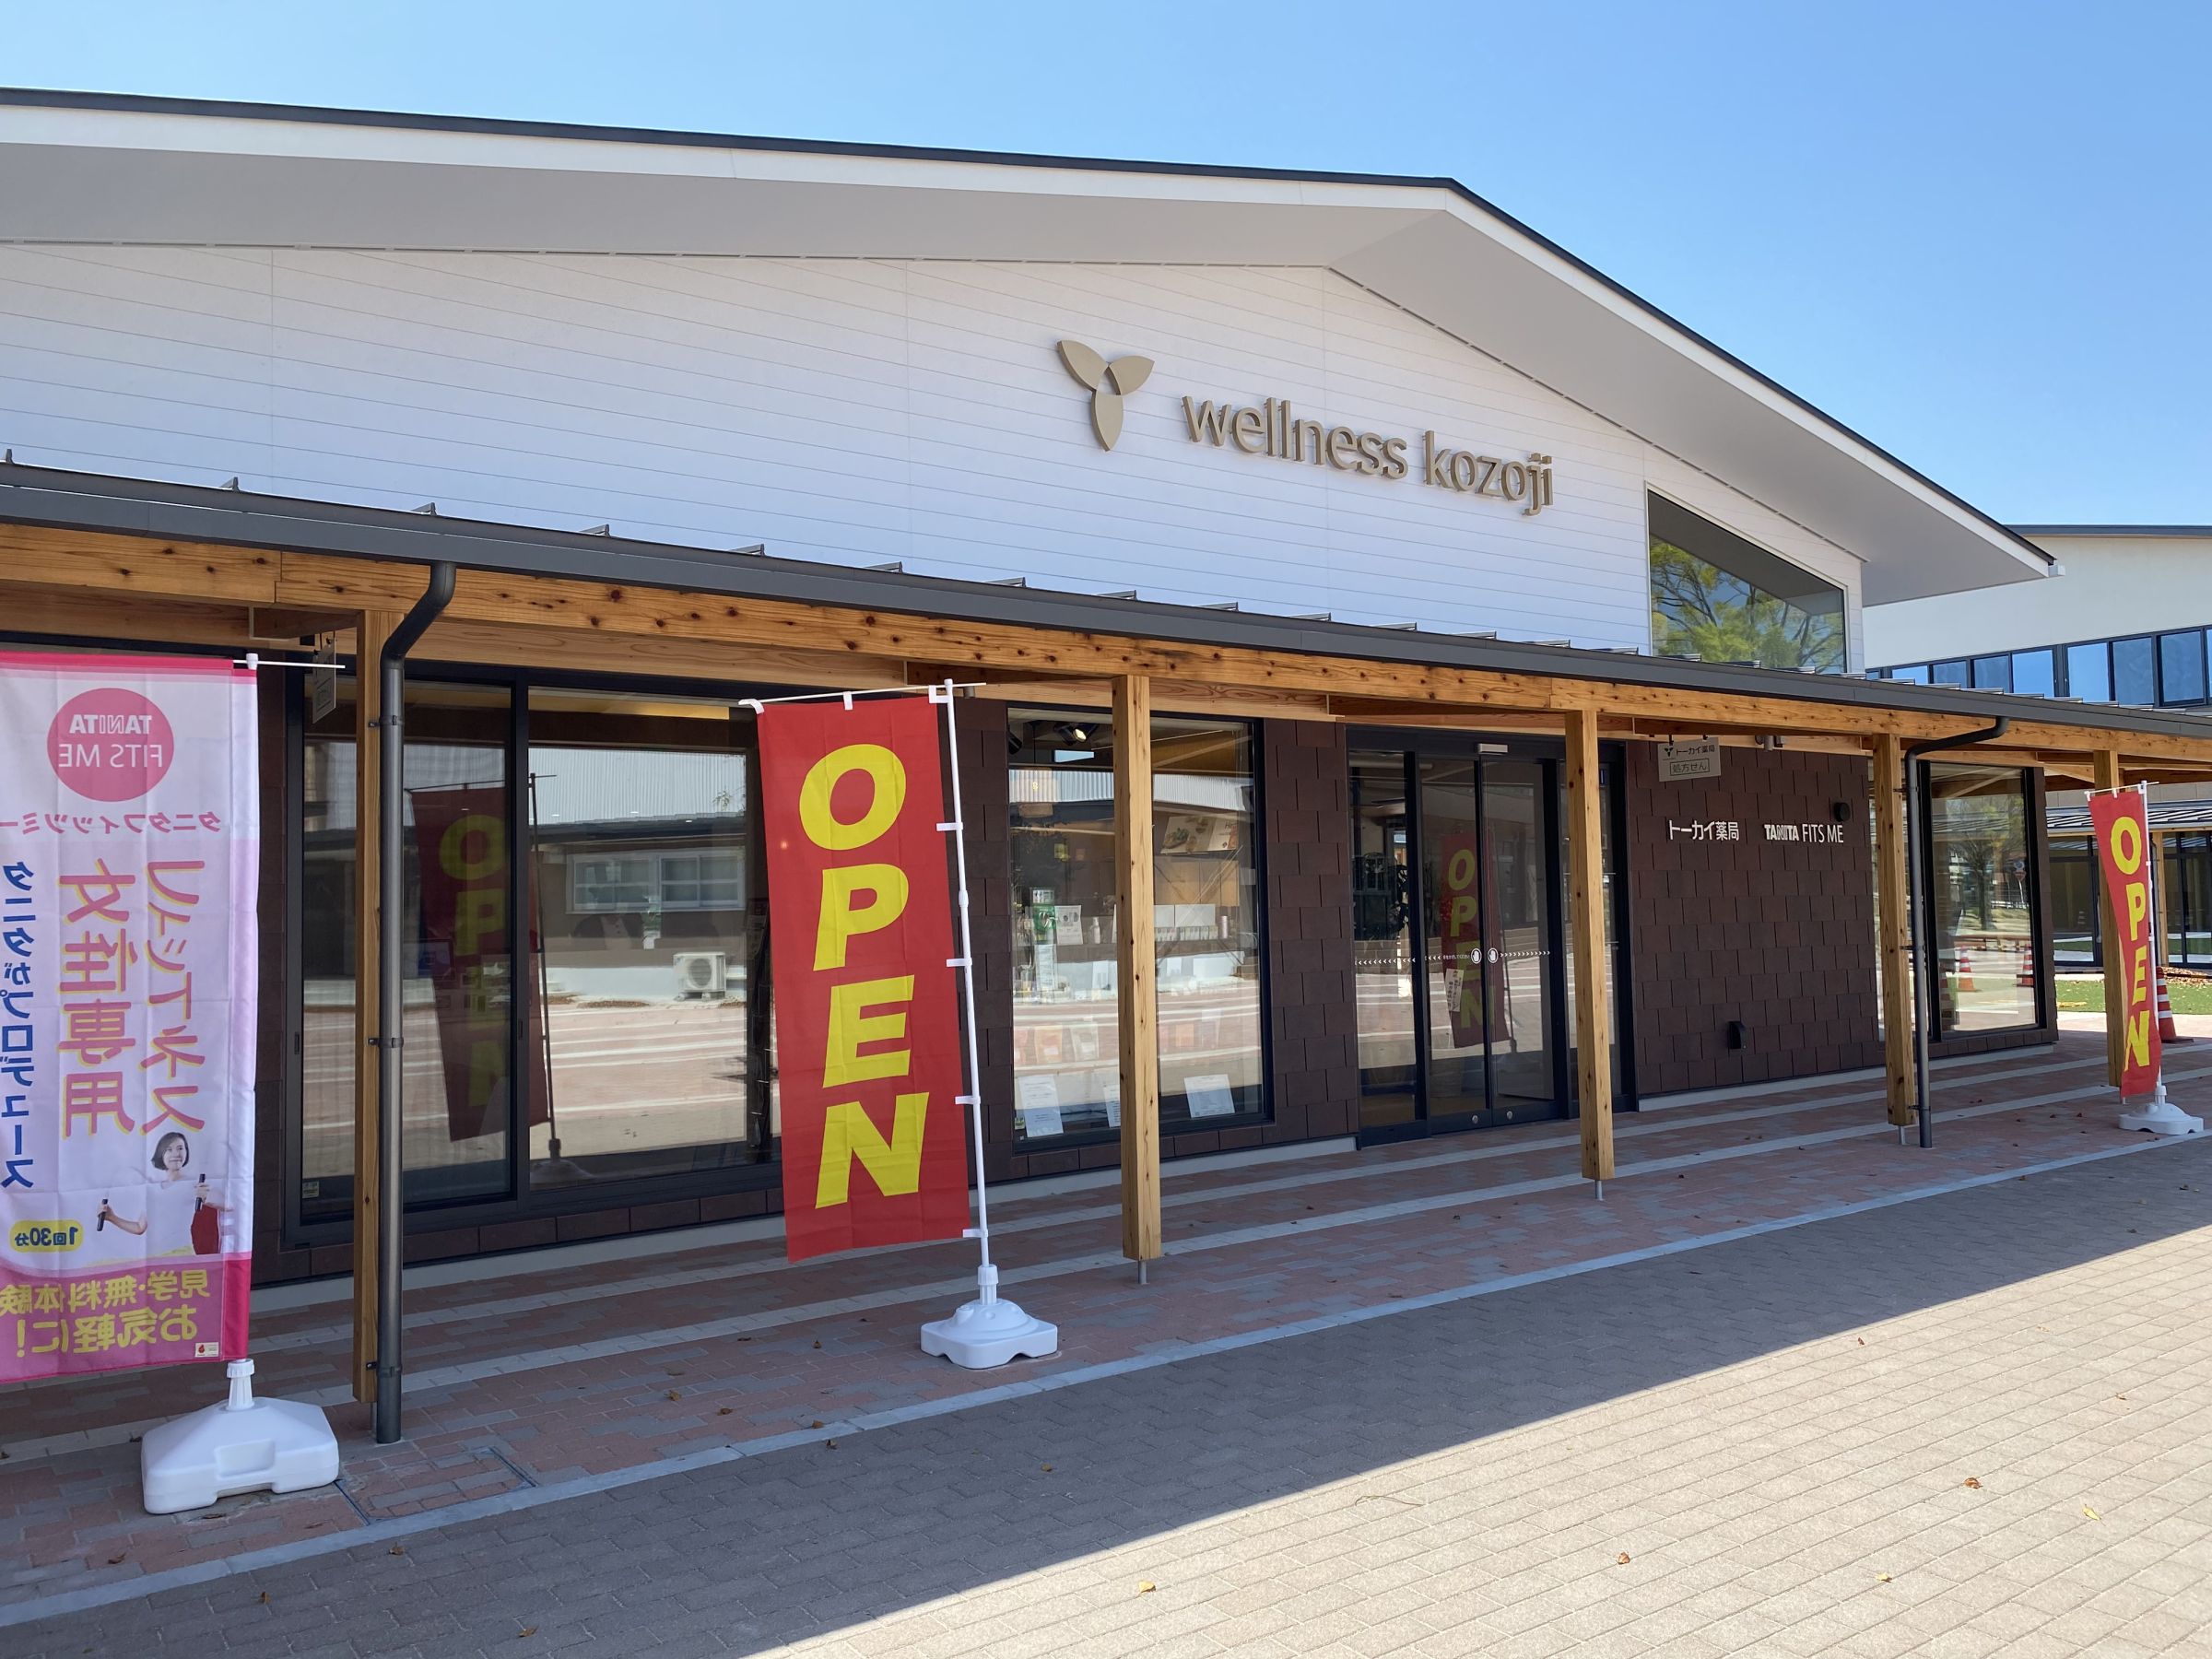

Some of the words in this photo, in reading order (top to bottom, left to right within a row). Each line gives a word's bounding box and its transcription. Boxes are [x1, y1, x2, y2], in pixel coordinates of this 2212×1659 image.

[1182, 396, 1407, 480] wellness
[1422, 430, 1554, 516] kozoji
[1668, 819, 1740, 841] トーカイ薬局
[1764, 824, 1800, 841] TANITA
[1801, 823, 1826, 843] FITS
[1827, 824, 1844, 843] ME
[799, 743, 930, 1209] OPEN
[2110, 817, 2151, 1071] OPEN
